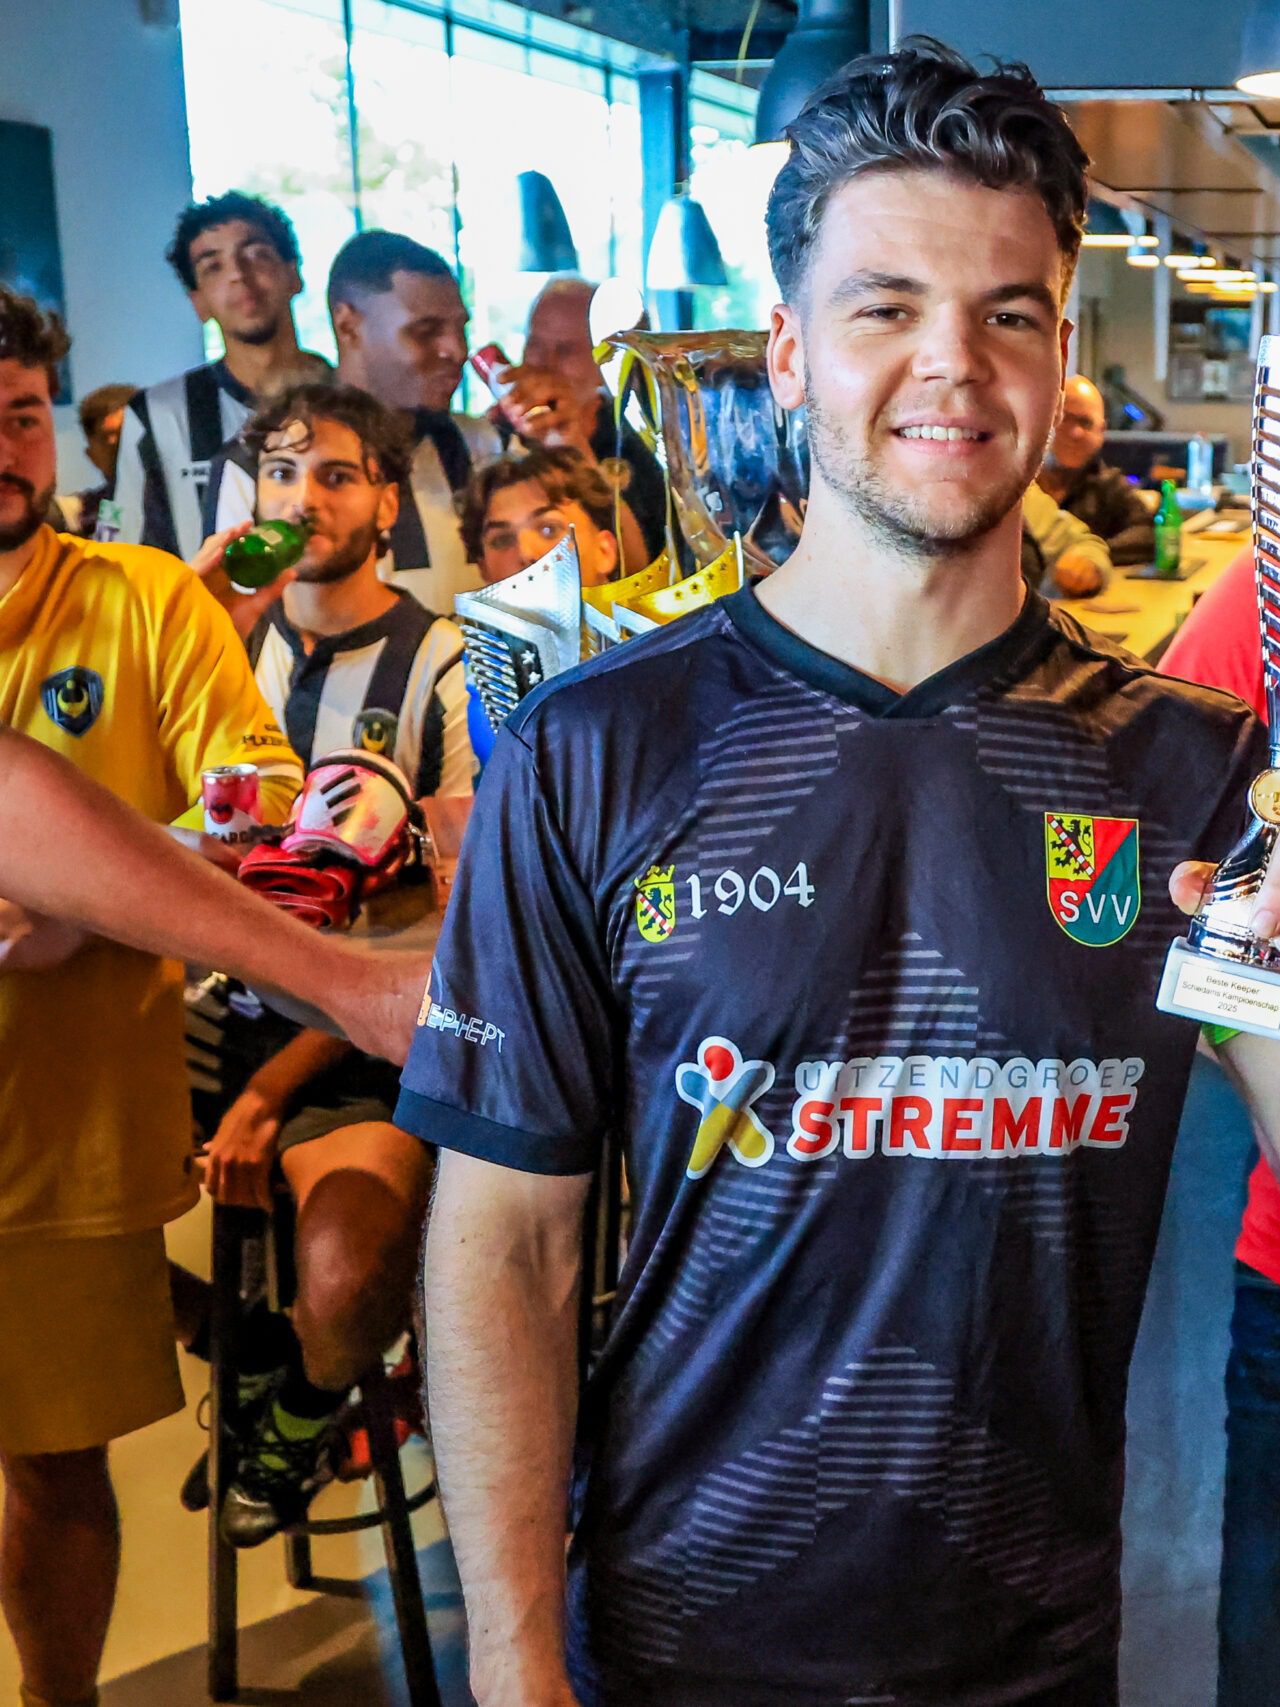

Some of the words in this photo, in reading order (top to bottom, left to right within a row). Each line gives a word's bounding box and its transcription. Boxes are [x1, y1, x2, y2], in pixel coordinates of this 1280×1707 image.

[686, 861, 815, 920] 1904
[1060, 891, 1132, 926] SVV
[1182, 981, 1221, 998] Schiedams
[1222, 991, 1280, 1012] Kampioenschap
[1206, 975, 1229, 988] Beste
[1231, 982, 1261, 995] Keeper
[1217, 1001, 1238, 1013] 2025
[802, 1062, 1141, 1092] UITZENDGROEP
[792, 1093, 1132, 1155] STREMME
